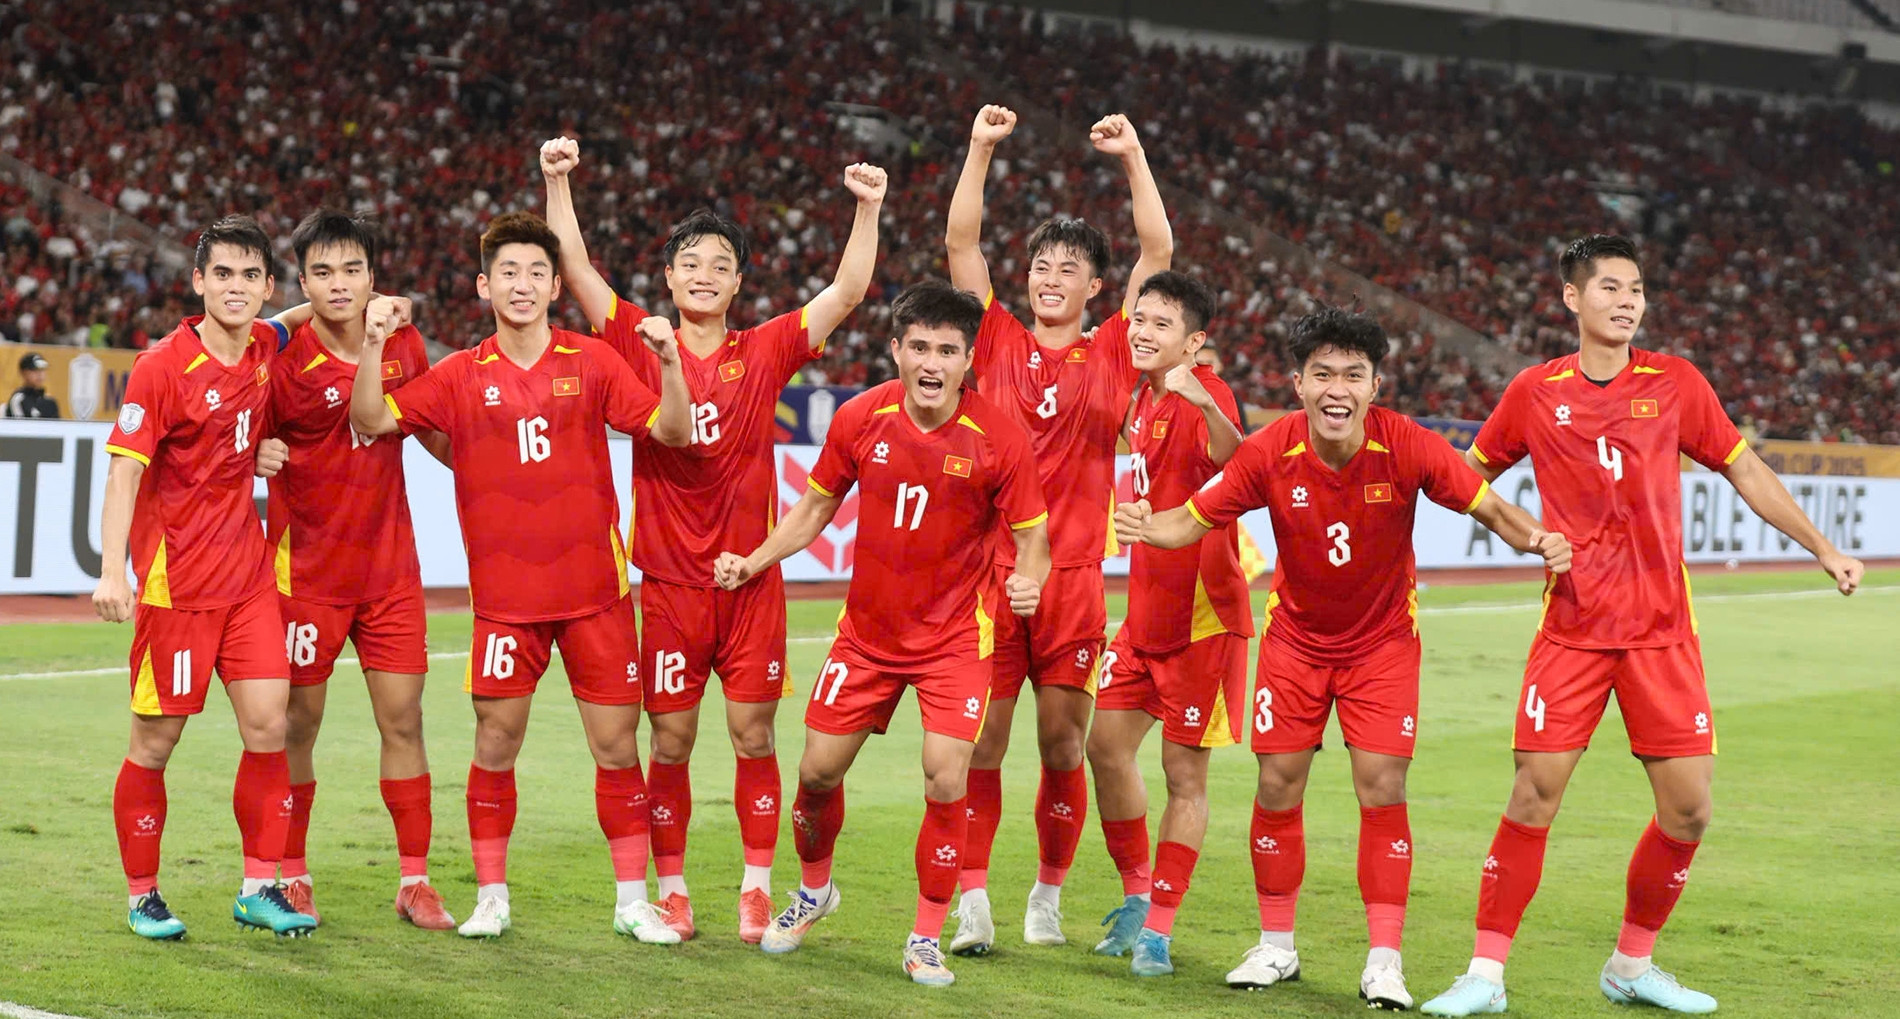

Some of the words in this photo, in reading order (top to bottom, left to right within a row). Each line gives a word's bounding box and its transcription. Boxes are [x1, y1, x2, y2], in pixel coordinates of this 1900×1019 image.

[235, 409, 251, 453] 11
[517, 416, 551, 464] 16
[690, 400, 721, 446] 12
[1596, 435, 1623, 481] 4
[894, 482, 929, 531] 17
[1327, 521, 1351, 567] 3
[286, 621, 318, 667] 18
[482, 632, 517, 680] 16
[173, 649, 191, 696] 11
[655, 650, 686, 695] 12
[814, 657, 849, 706] 17
[1256, 687, 1274, 734] 3
[1525, 684, 1546, 732] 4
